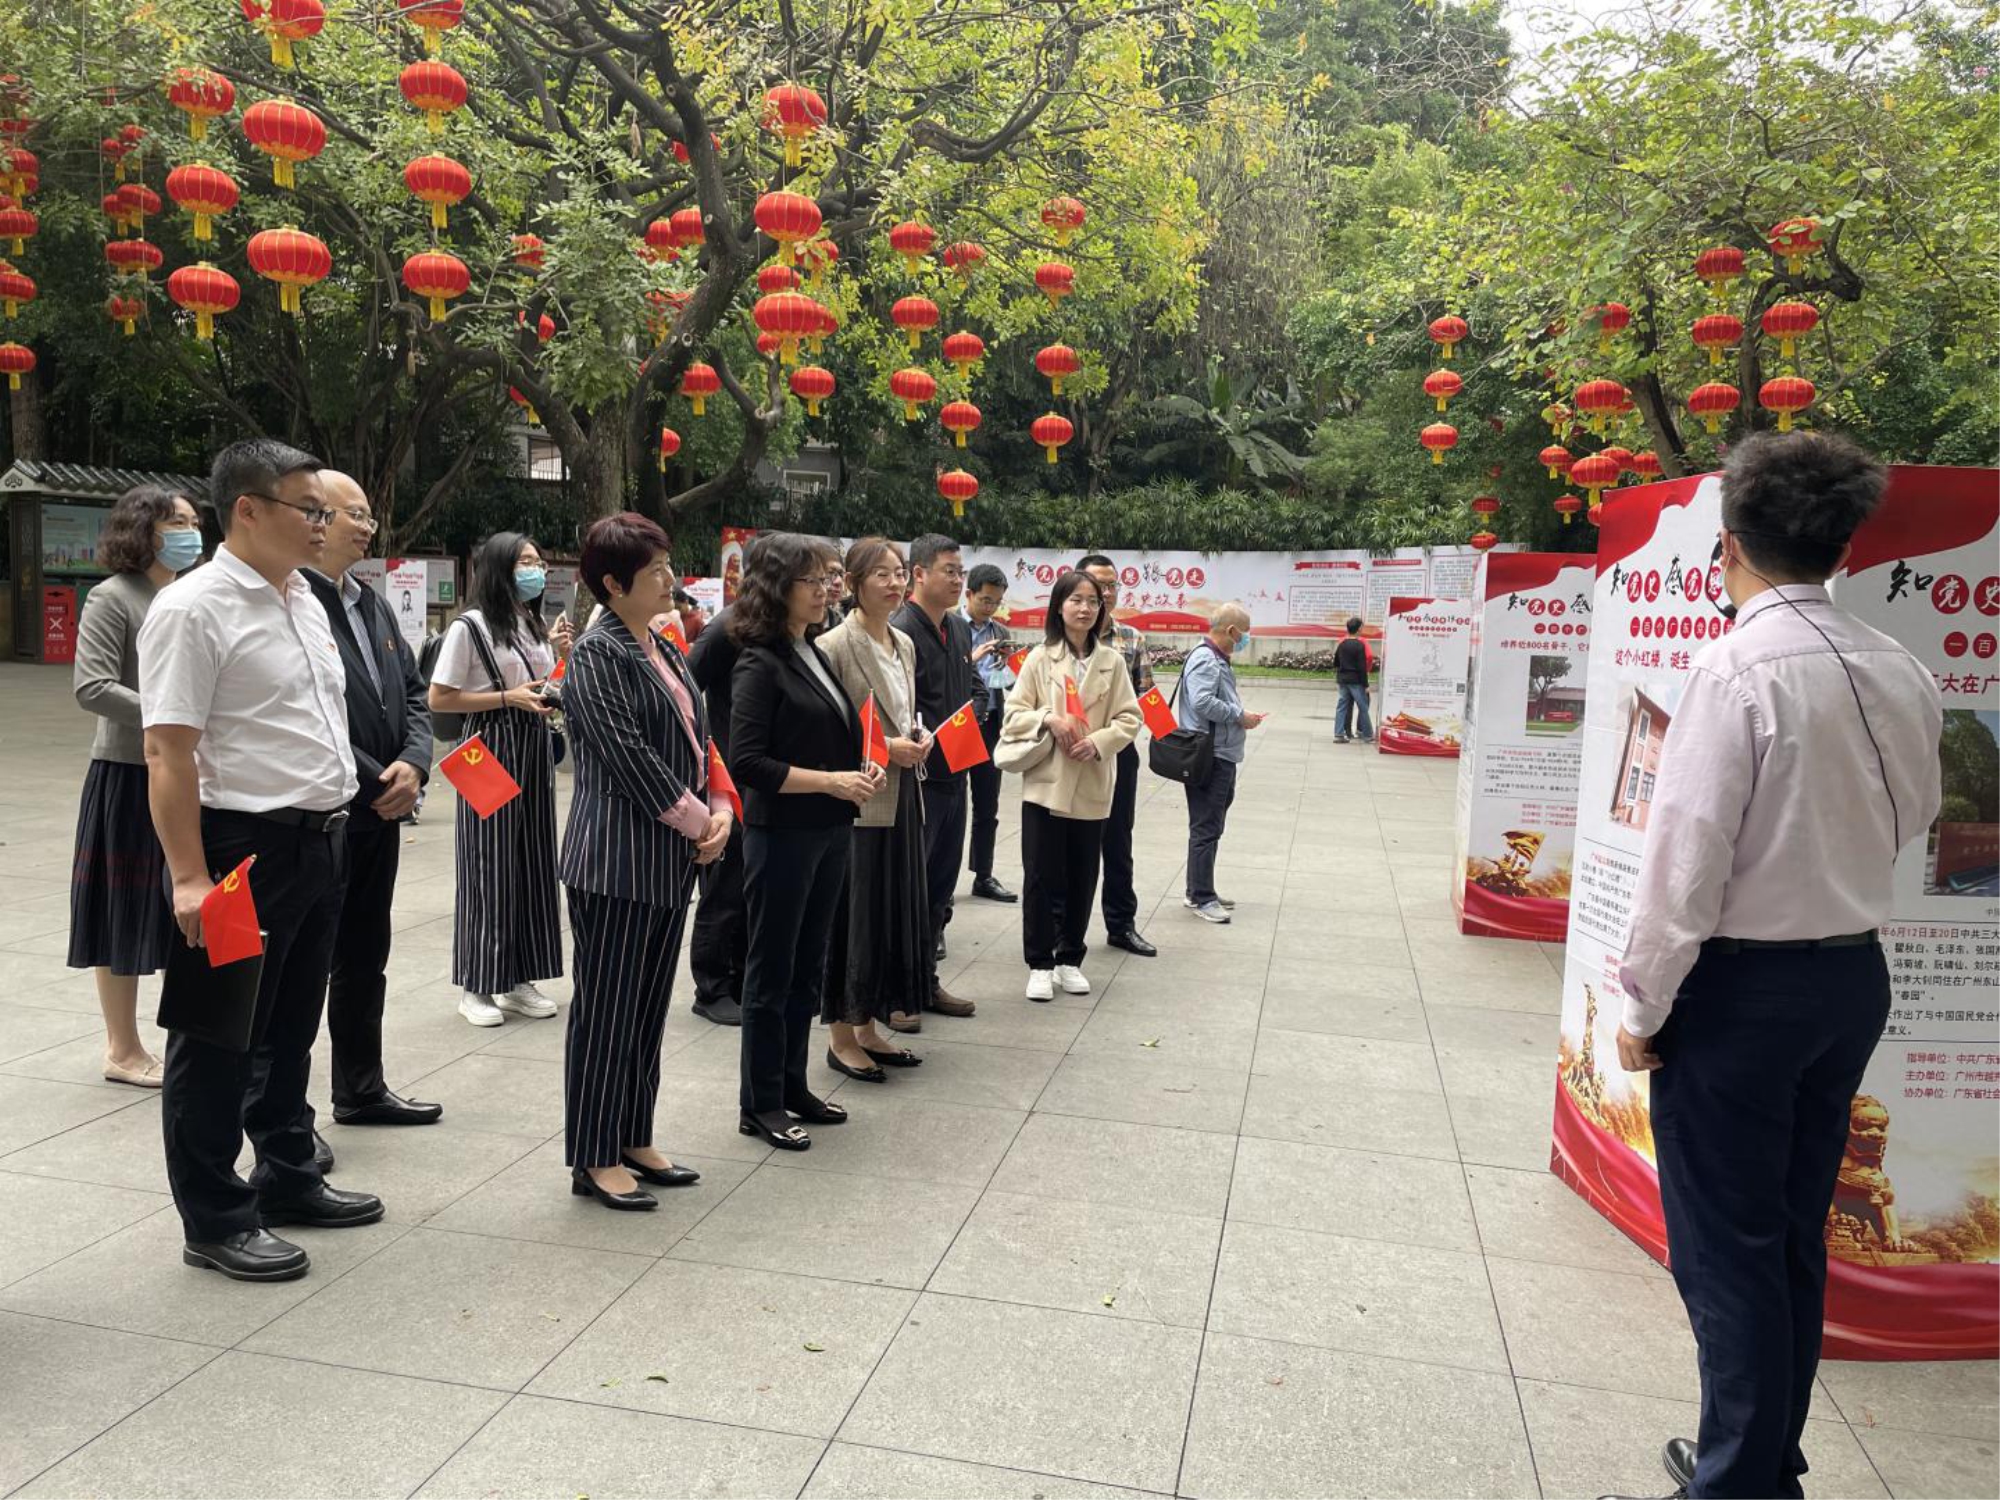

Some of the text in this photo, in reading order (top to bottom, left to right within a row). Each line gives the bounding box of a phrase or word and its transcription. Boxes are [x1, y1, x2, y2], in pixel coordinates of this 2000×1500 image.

[1886, 559, 1998, 617] 知党史
[1944, 631, 1997, 659] 一百
